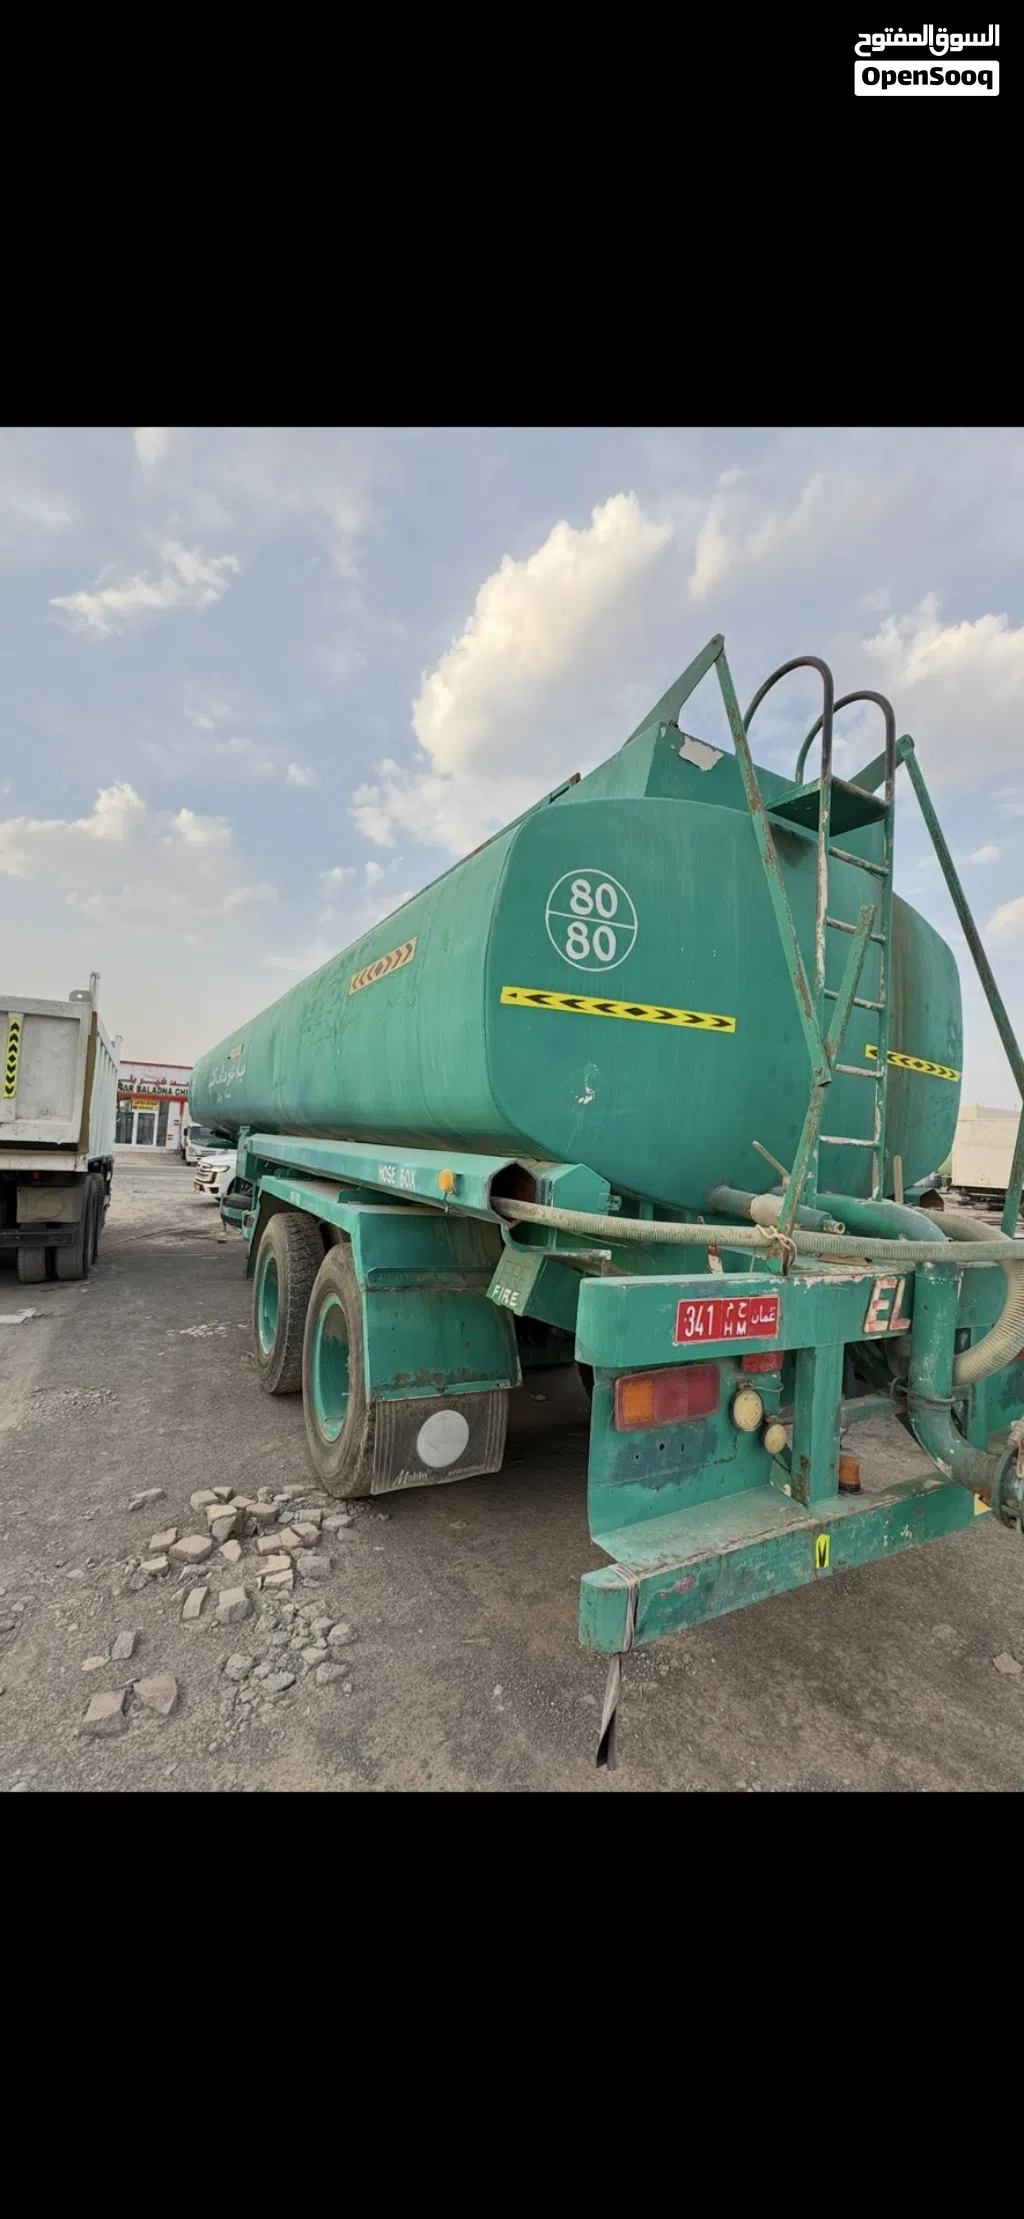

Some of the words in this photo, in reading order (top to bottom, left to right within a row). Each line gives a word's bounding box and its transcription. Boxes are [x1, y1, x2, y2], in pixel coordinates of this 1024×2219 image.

[569, 878, 618, 919] 80
[565, 921, 617, 962] 80
[136, 1085, 173, 1096] BALADNA
[379, 1164, 397, 1185] HOSE
[399, 1168, 416, 1189] BOX
[491, 1284, 521, 1307] FIRE
[863, 1276, 912, 1333] EL
[684, 1304, 715, 1337] 341
